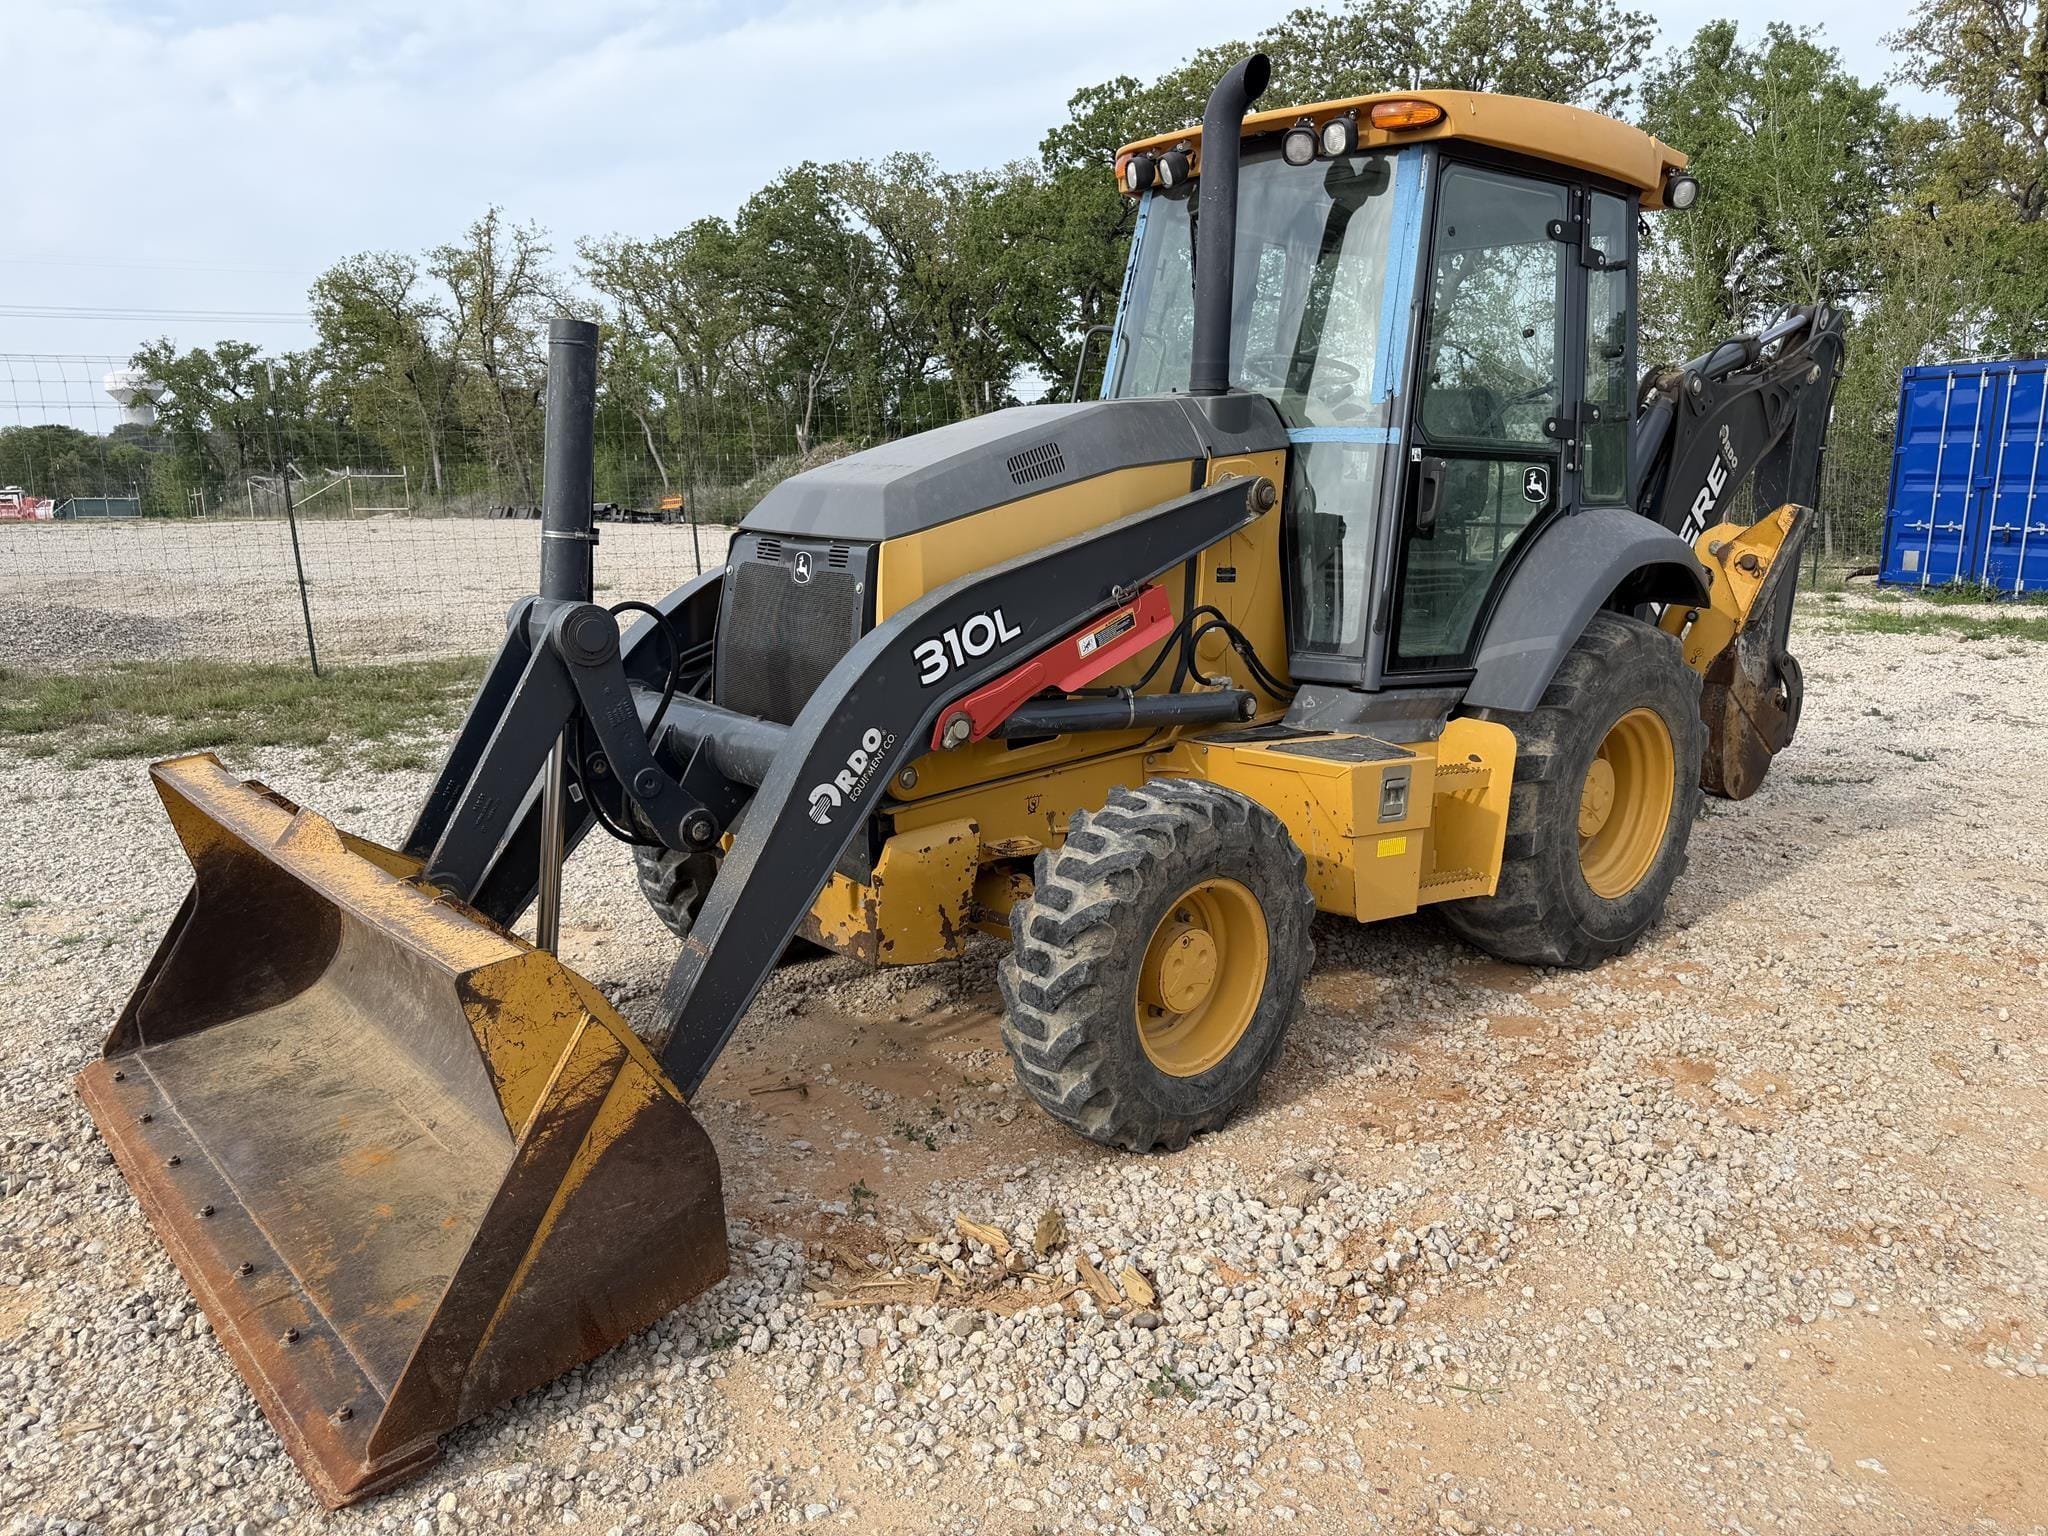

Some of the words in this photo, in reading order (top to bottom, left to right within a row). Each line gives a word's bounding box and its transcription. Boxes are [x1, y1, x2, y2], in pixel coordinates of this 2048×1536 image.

[1679, 454, 1728, 549] ERE
[913, 609, 1021, 685] 310L
[849, 749, 885, 802] EQUIPMENT
